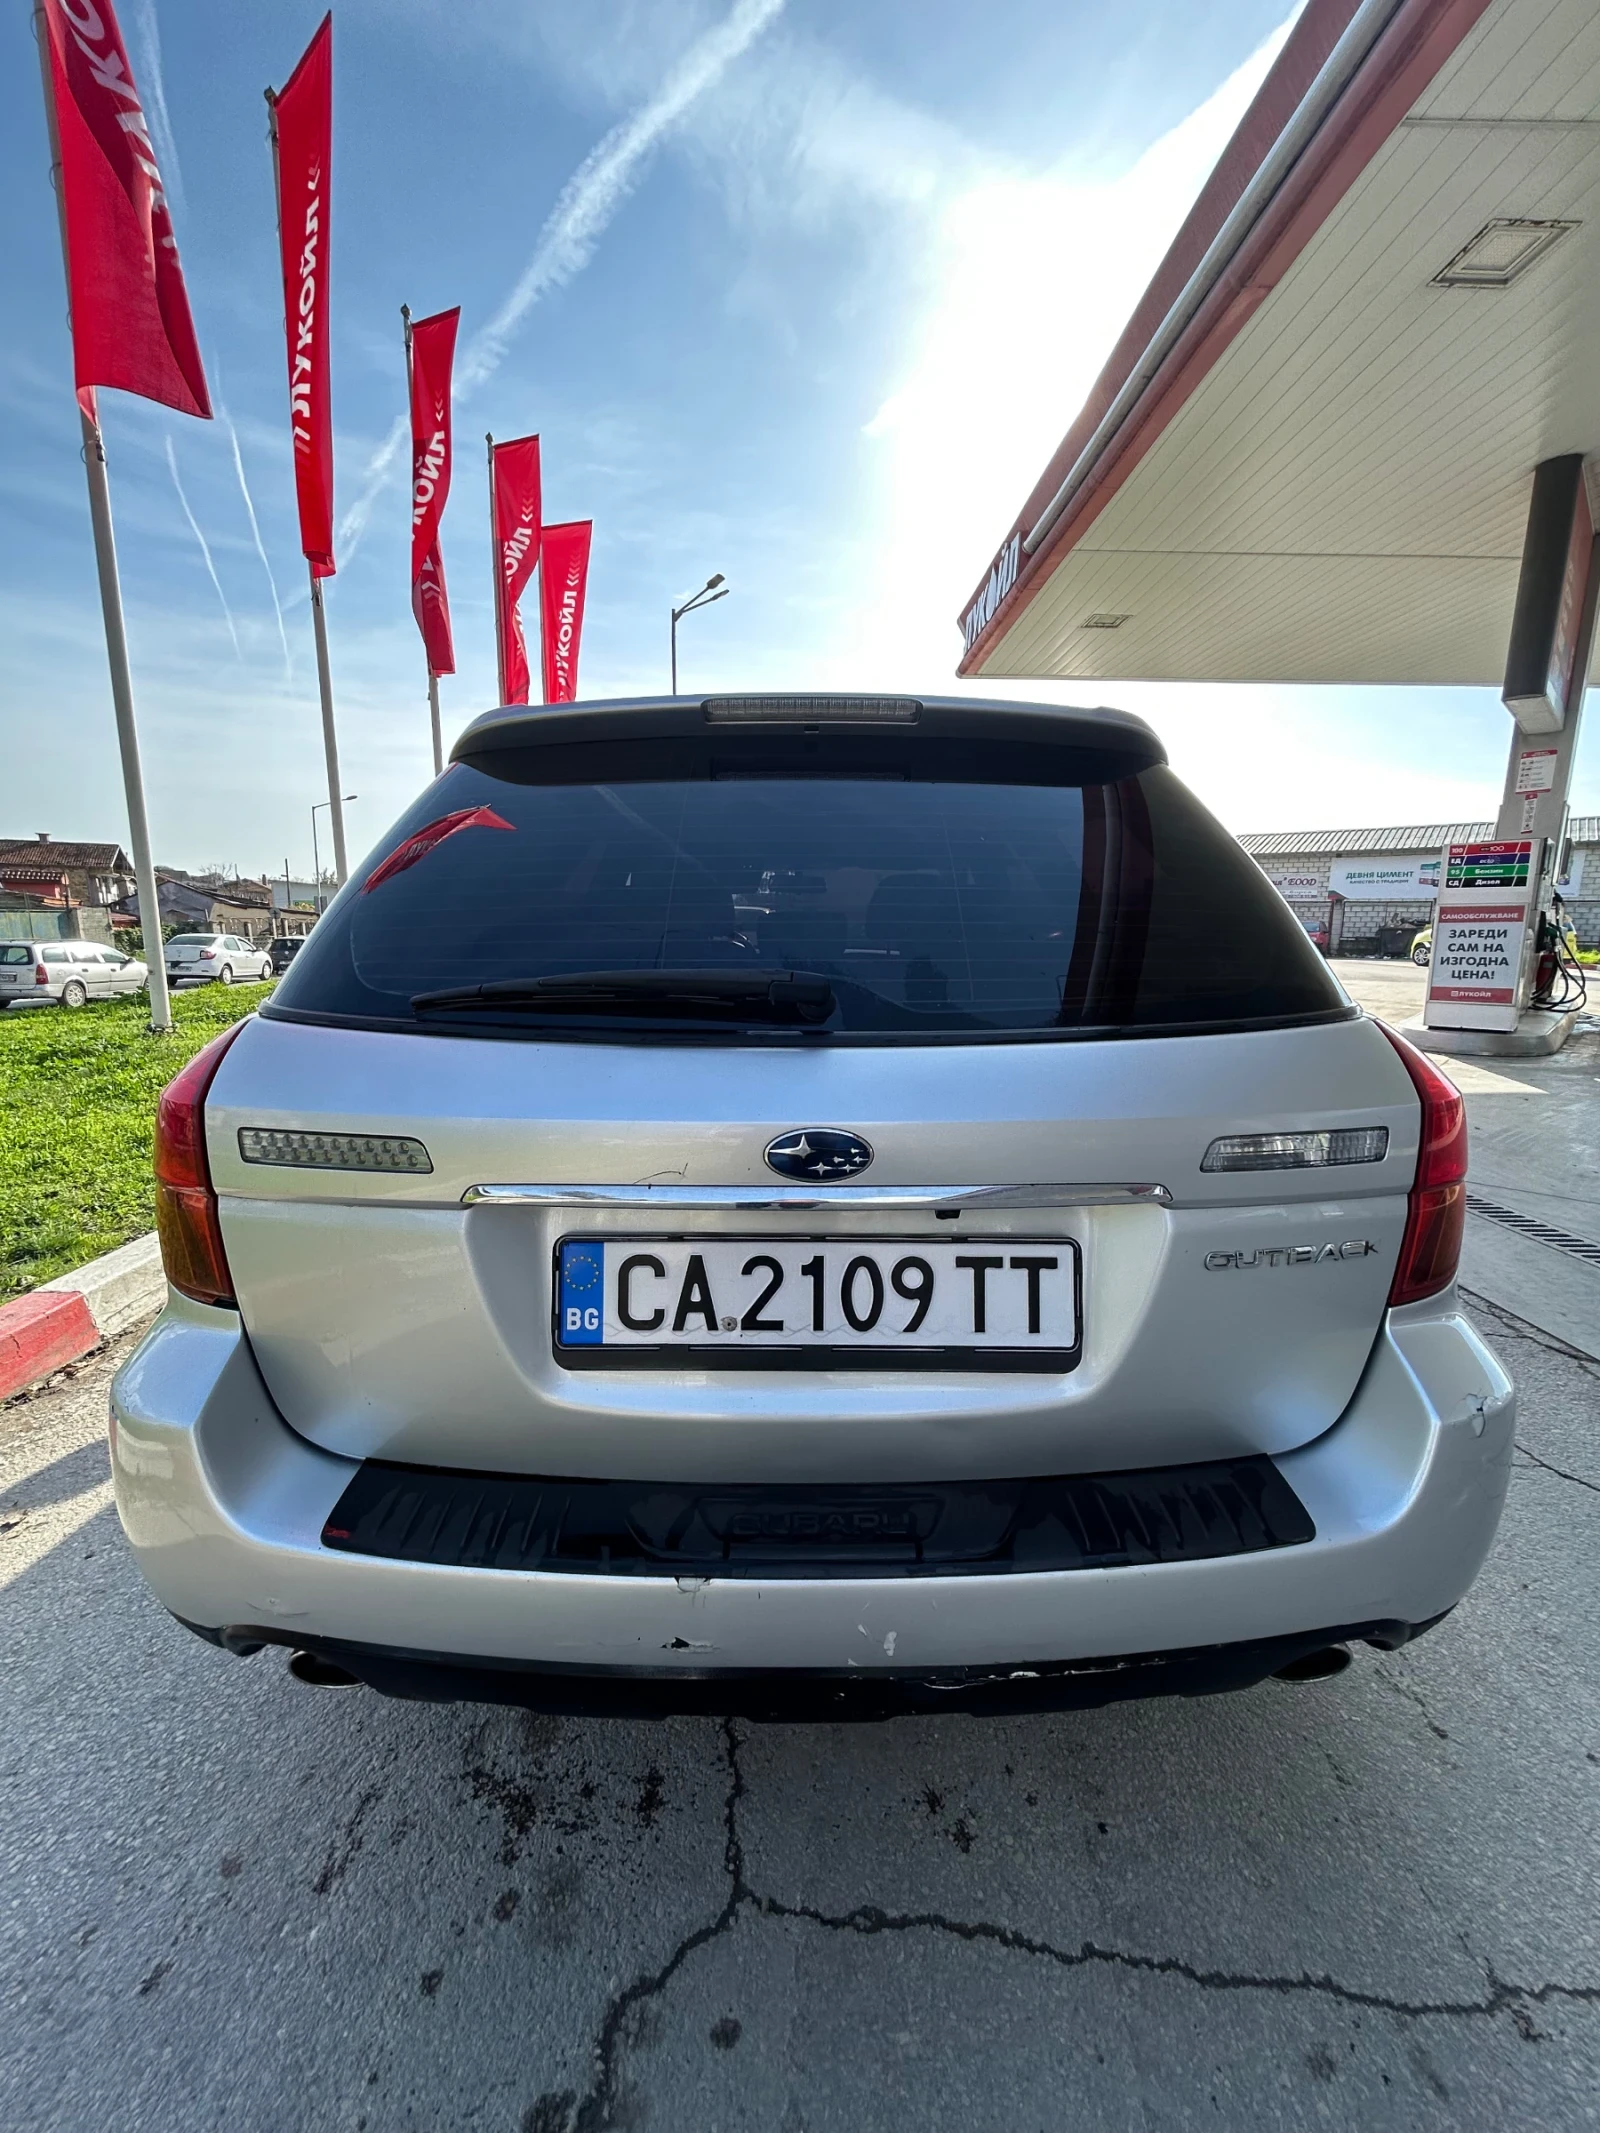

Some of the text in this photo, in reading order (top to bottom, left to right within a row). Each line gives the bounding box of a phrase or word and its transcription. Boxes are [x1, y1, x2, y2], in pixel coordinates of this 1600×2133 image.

[291, 195, 320, 418] ЛУКОЙЛ
[1345, 870, 1414, 880] ДЕВНЯ ЦИМЕНТ
[1475, 867, 1504, 875] Бензин
[1441, 912, 1519, 920] САМООБСЛУЖВАНЕ
[1448, 929, 1508, 940] ЗАРЕДИ
[1447, 943, 1505, 953] САМ НА
[1440, 956, 1509, 967] ИЗГОДНА
[1451, 970, 1495, 980] ЦЕНА!
[1458, 990, 1492, 998] ЛУКОЙЛ
[1204, 1239, 1379, 1271] OUTBACK
[566, 1307, 599, 1331] BG
[732, 1513, 913, 1536] SUBARU
